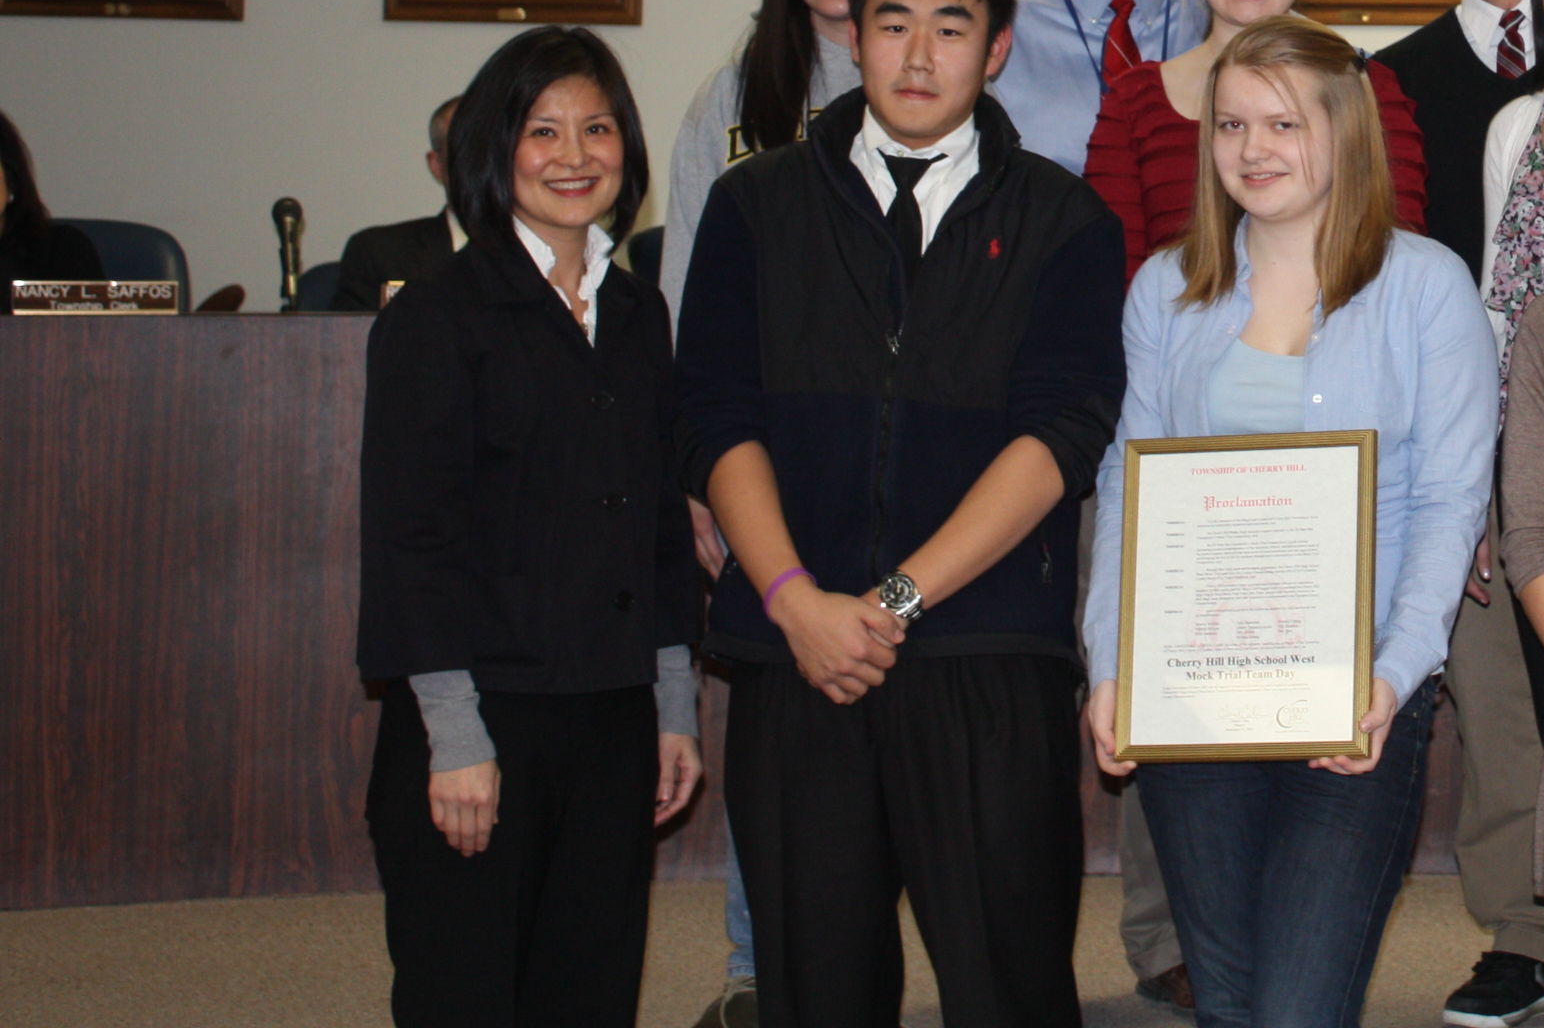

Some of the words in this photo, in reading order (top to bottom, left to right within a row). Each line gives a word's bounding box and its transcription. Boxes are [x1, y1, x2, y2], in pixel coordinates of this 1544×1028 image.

[15, 285, 71, 299] NANCY
[81, 285, 97, 299] L.
[107, 285, 173, 299] SAFFOS
[1191, 467, 1235, 476] TOWNSHIP
[1249, 465, 1284, 473] CHERRY
[1286, 464, 1307, 472] HILL
[1203, 495, 1293, 511] Proclamation
[1167, 658, 1202, 669] Cherry
[1206, 657, 1225, 667] Hill
[1227, 656, 1252, 667] High
[1254, 655, 1288, 665] School
[1290, 654, 1316, 664] West
[1185, 671, 1214, 681] Mock
[1218, 670, 1242, 680] Trial
[1246, 670, 1273, 679] Team
[1276, 668, 1296, 680] Day
